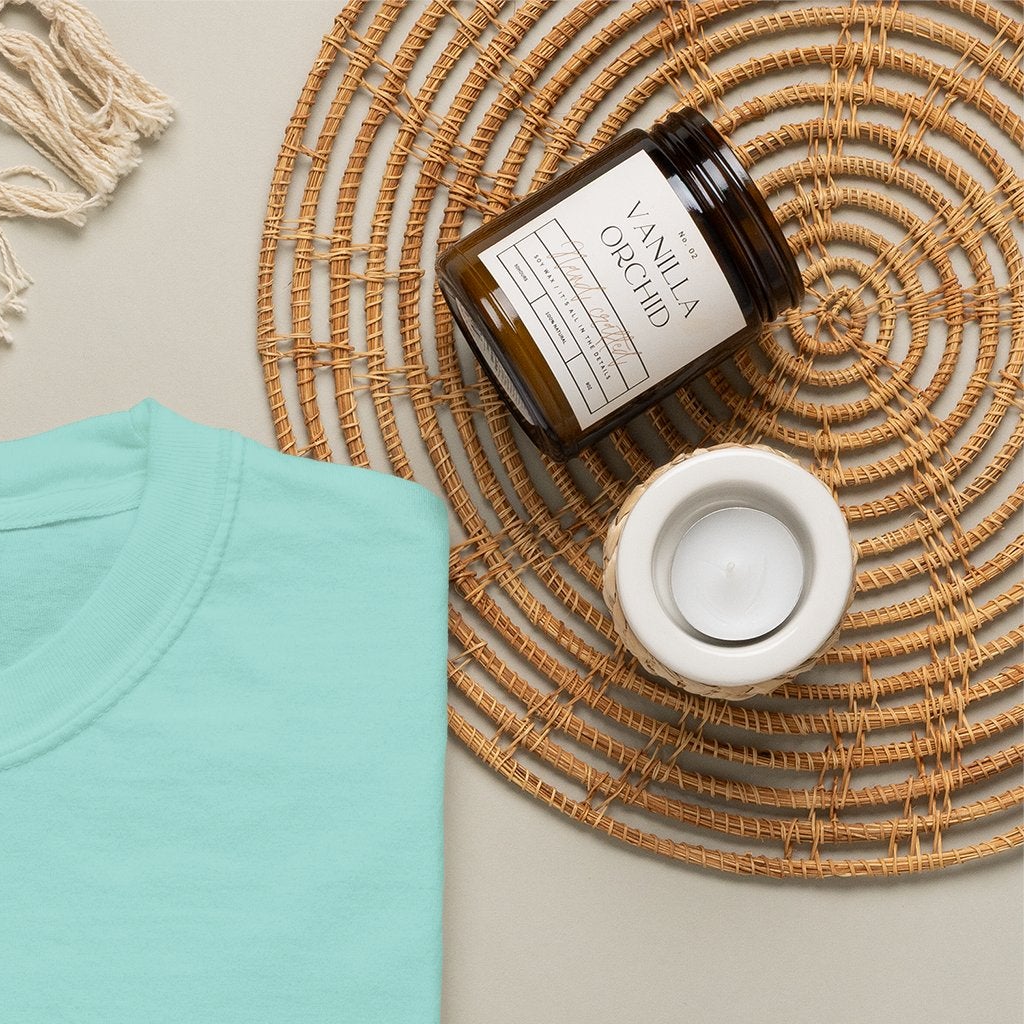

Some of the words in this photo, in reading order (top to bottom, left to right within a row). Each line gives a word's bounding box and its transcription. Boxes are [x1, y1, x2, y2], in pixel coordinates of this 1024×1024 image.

[600, 225, 670, 328] ORCHID
[626, 200, 700, 318] VANILLA
[688, 247, 698, 260] 02
[534, 254, 544, 267] SOY
[543, 269, 555, 284] WAX
[569, 309, 579, 323] ALL
[578, 324, 586, 334] IN
[585, 335, 597, 350] THE
[593, 352, 611, 380] DETAILS
